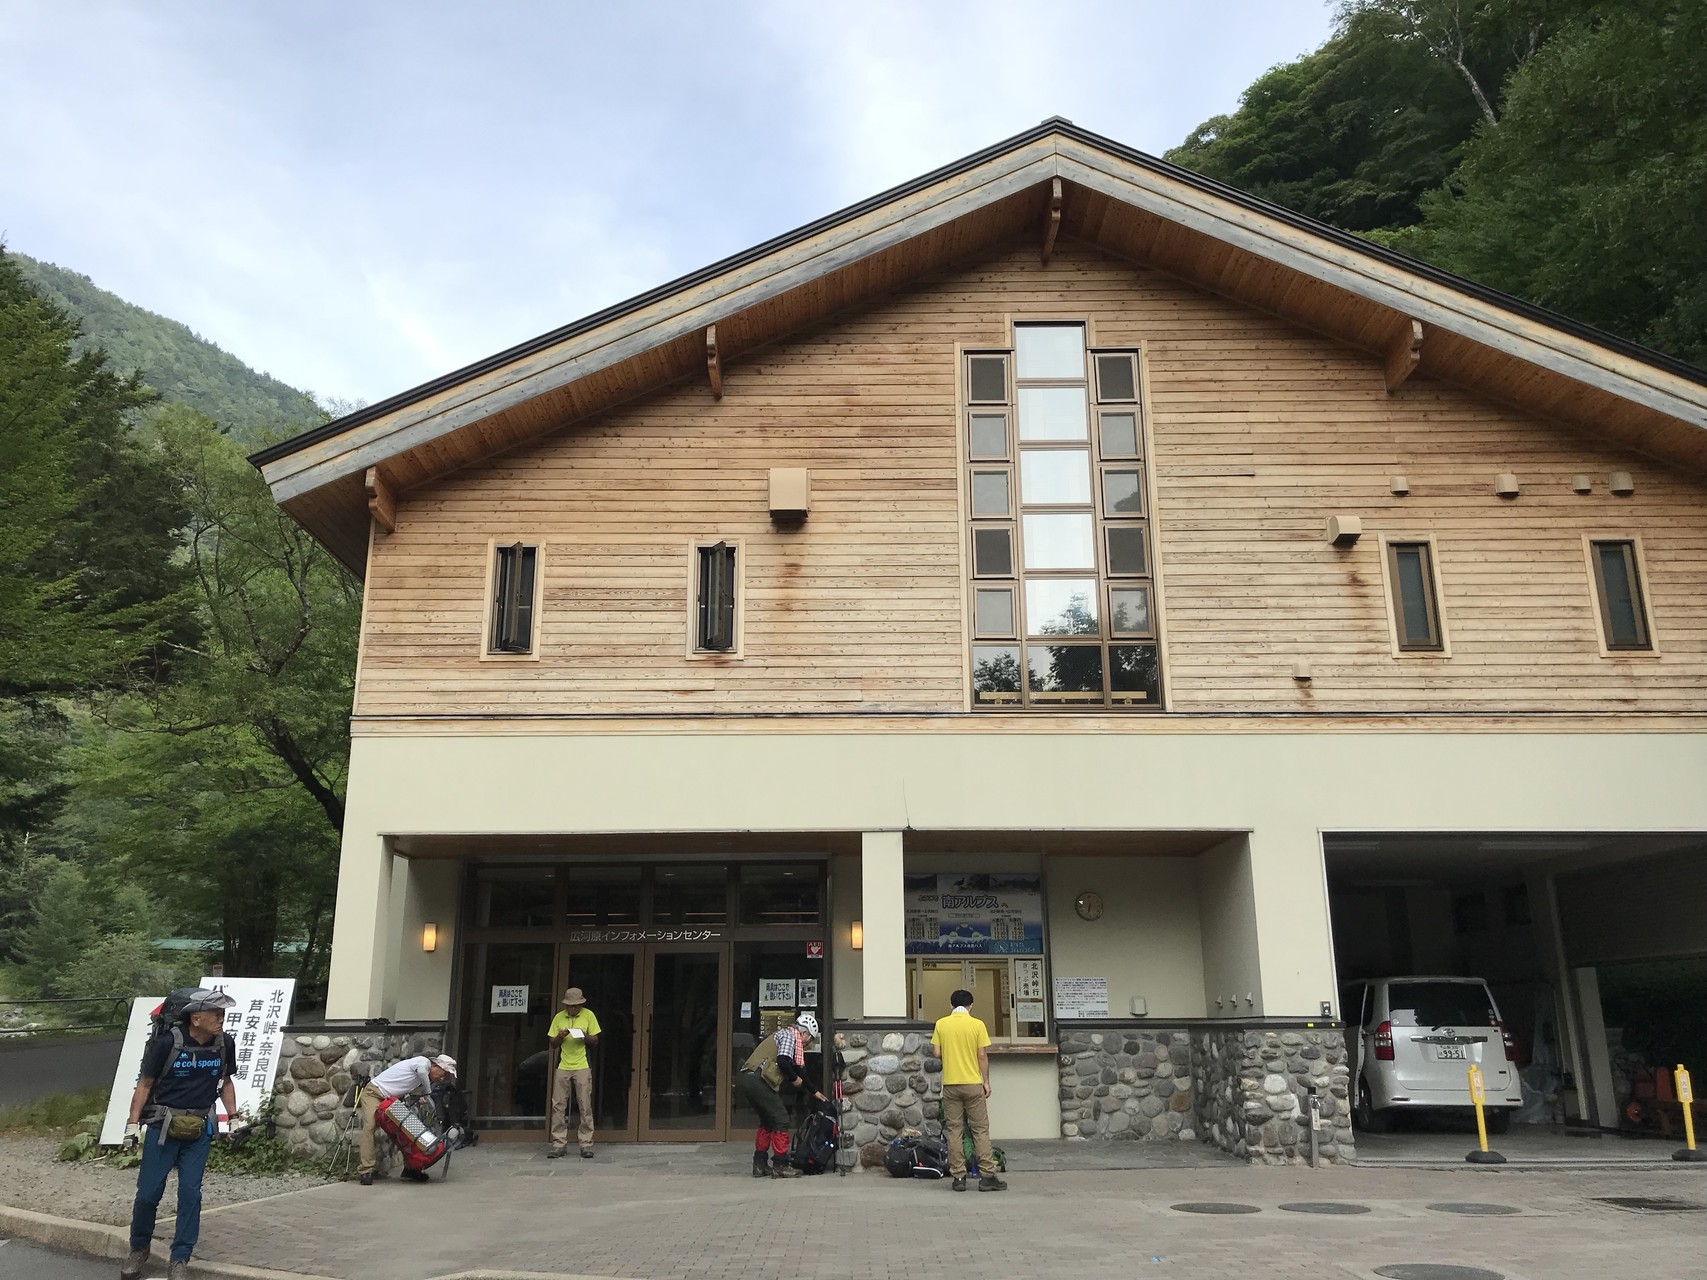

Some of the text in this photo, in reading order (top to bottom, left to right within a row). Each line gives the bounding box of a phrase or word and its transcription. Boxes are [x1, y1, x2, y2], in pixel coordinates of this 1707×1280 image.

[941, 893, 999, 909] 南アルプス
[570, 930, 721, 942] 広河原インフォメーションセンター
[1022, 962, 1030, 997] きっぷ売場
[1031, 962, 1040, 996] 北沢峠行
[233, 999, 264, 1081] 芦安駐車場
[251, 989, 285, 1089] 北沢峠・奈良田
